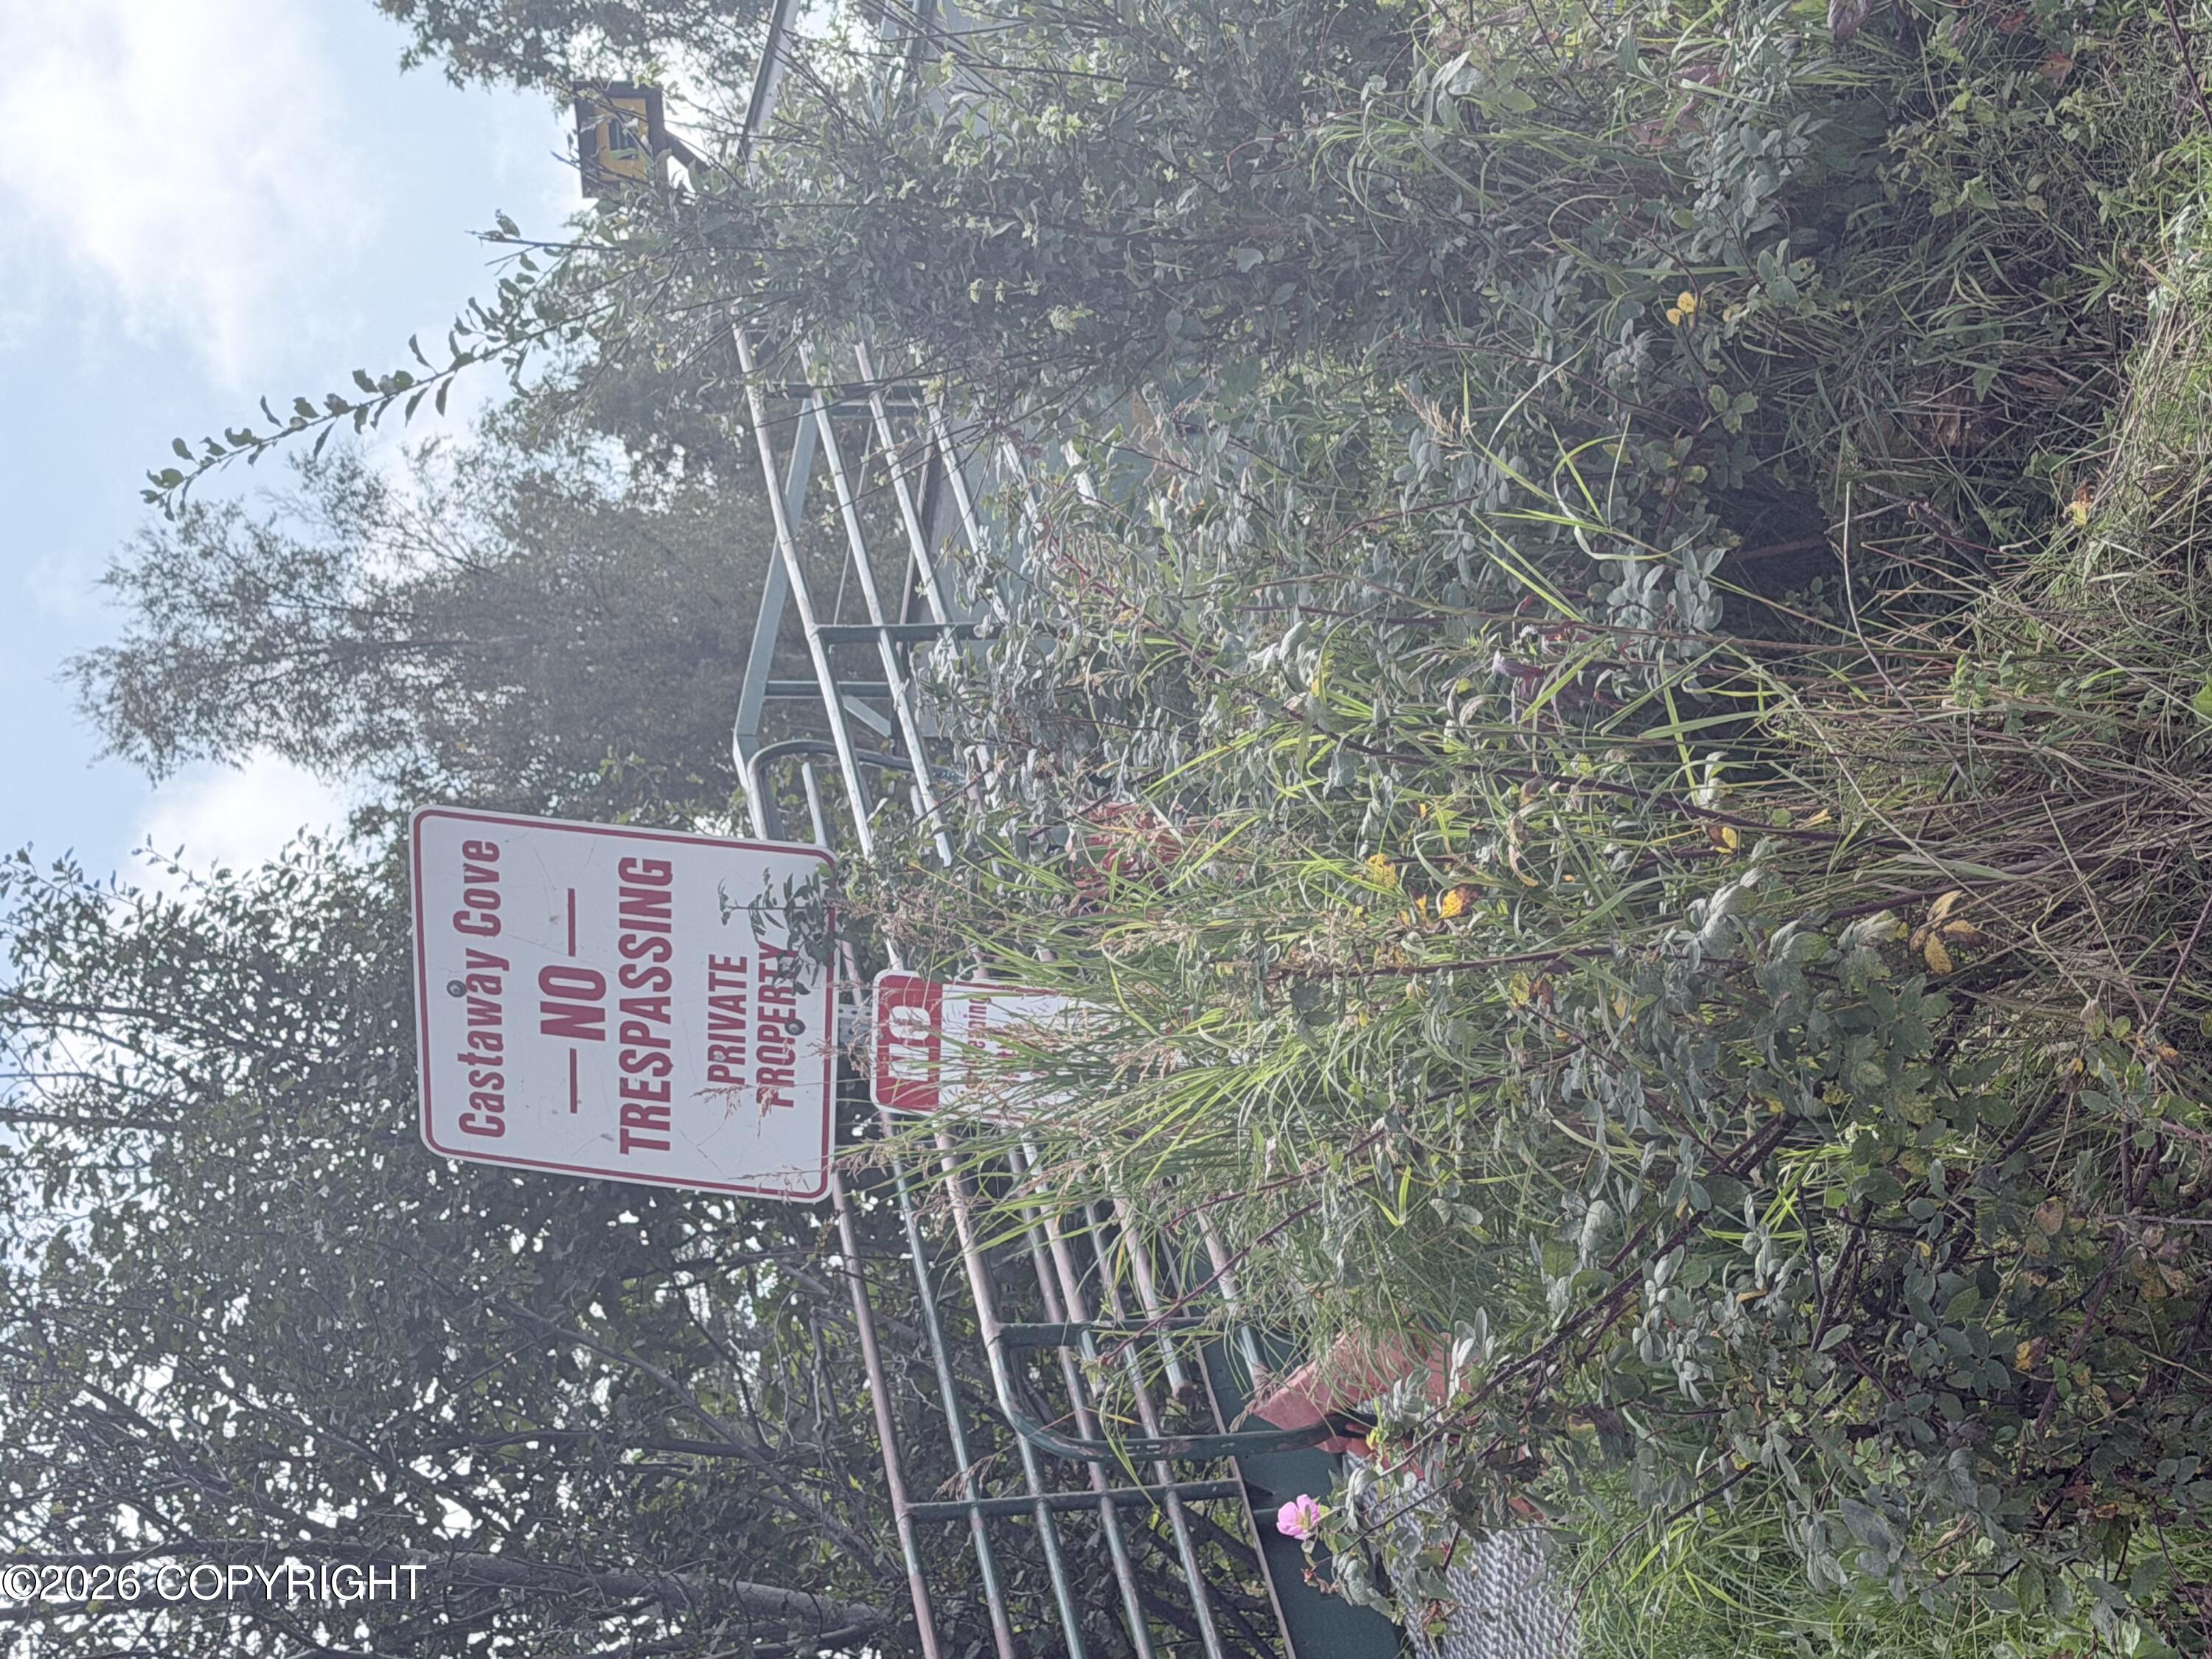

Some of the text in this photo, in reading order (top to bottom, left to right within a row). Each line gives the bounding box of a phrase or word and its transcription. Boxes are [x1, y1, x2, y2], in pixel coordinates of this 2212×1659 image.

[453, 840, 509, 1138] Castaway Cove
[538, 965, 607, 1041] NO
[618, 857, 674, 1155] TRESPASSING
[707, 953, 748, 1085] PRIVATE
[888, 1005, 931, 1082] NO
